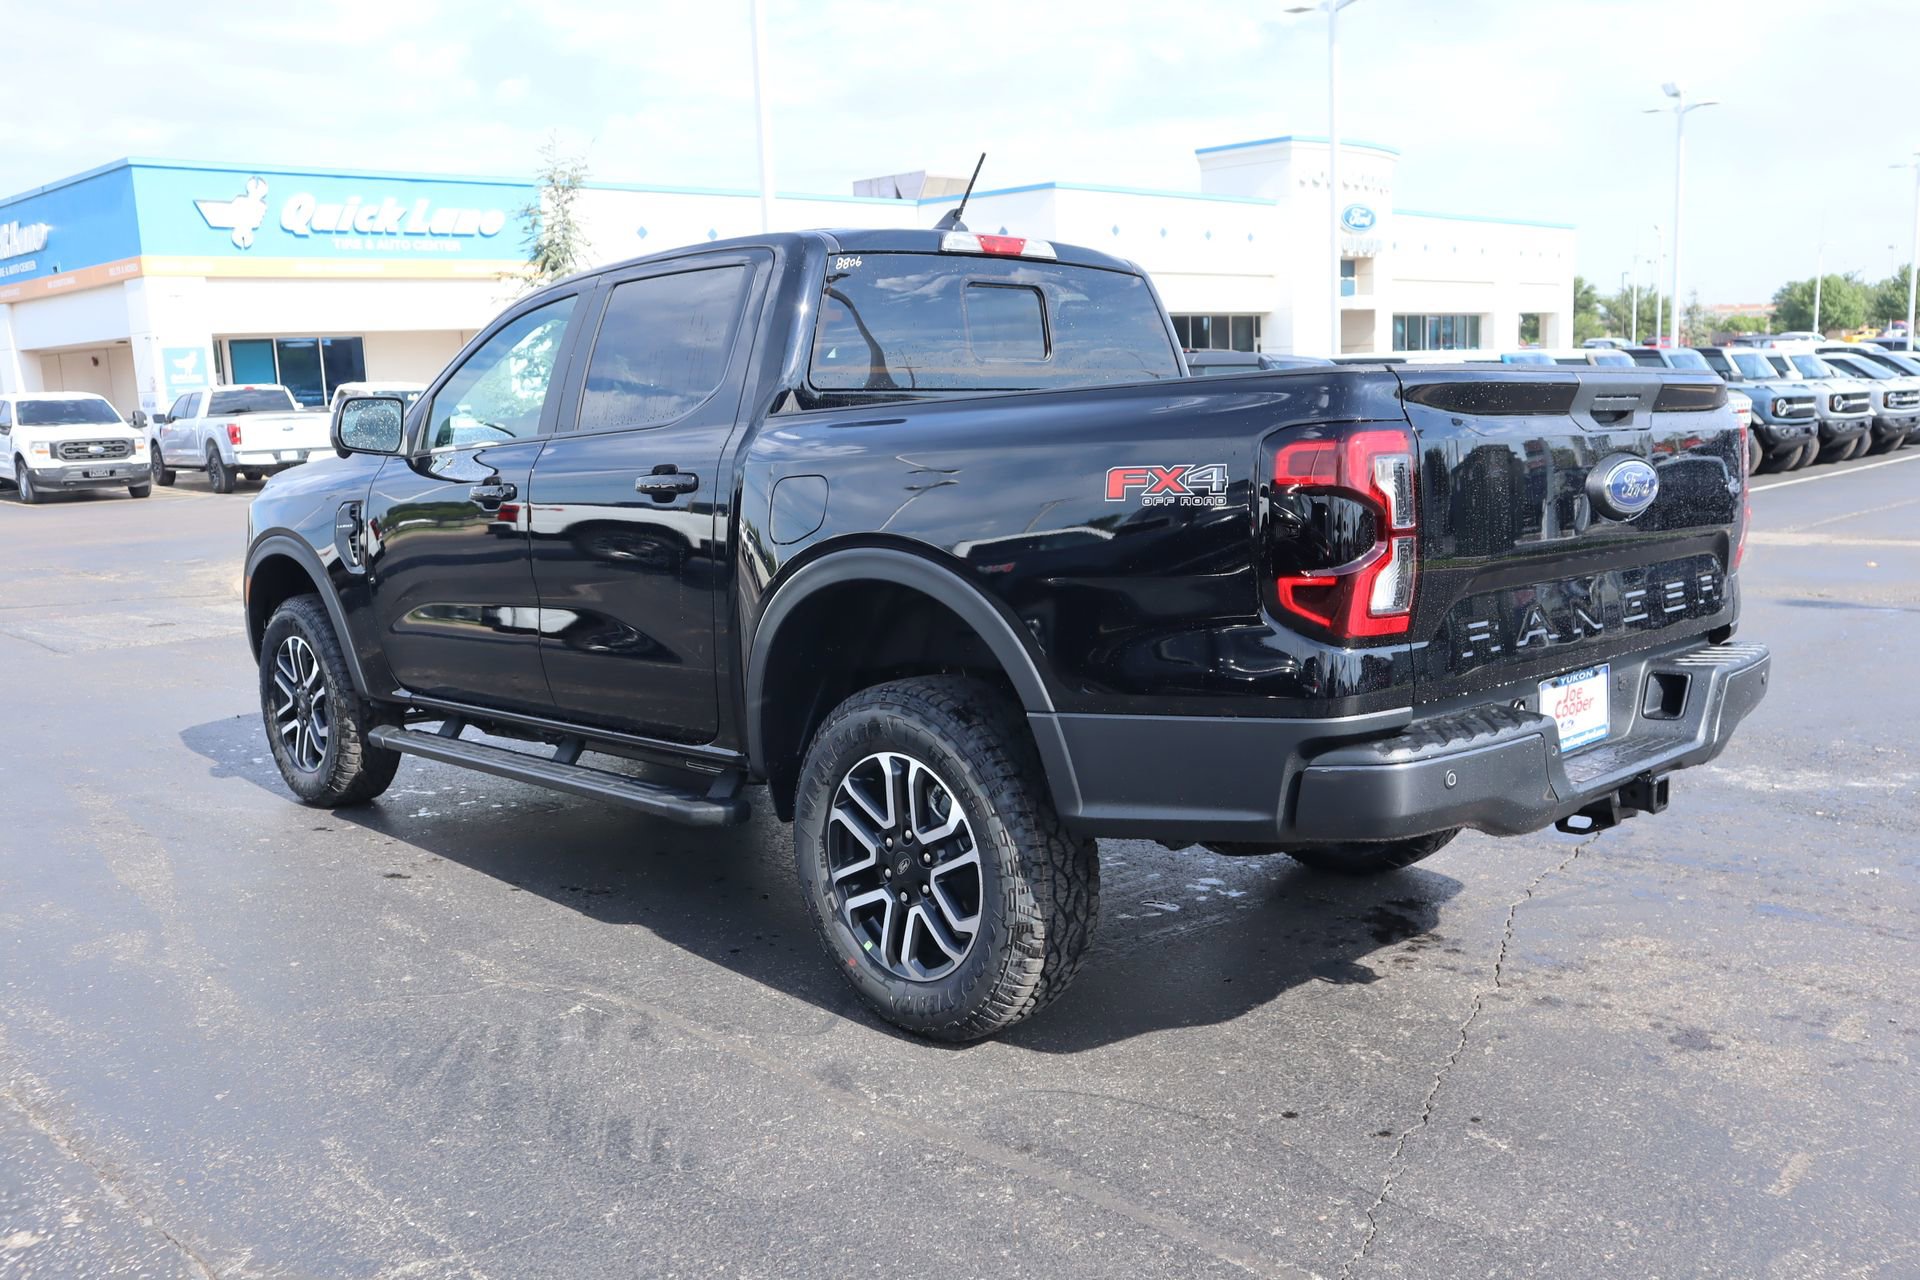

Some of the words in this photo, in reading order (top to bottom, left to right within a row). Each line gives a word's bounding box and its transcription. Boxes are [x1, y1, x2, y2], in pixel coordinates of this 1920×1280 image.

[280, 192, 407, 239] Quick
[1348, 207, 1373, 227] Ford
[377, 239, 411, 251] AUTO
[413, 239, 462, 252] CENTER
[835, 256, 863, 270] 8806
[1105, 464, 1229, 501] FX4
[1621, 471, 1650, 499] Ford
[1141, 496, 1175, 507] OFF
[1180, 496, 1227, 507] ROAD
[1461, 574, 1720, 659] RANGER
[1560, 669, 1594, 685] YUKON
[1562, 684, 1584, 704] Joe
[1554, 697, 1595, 720] Cooper
